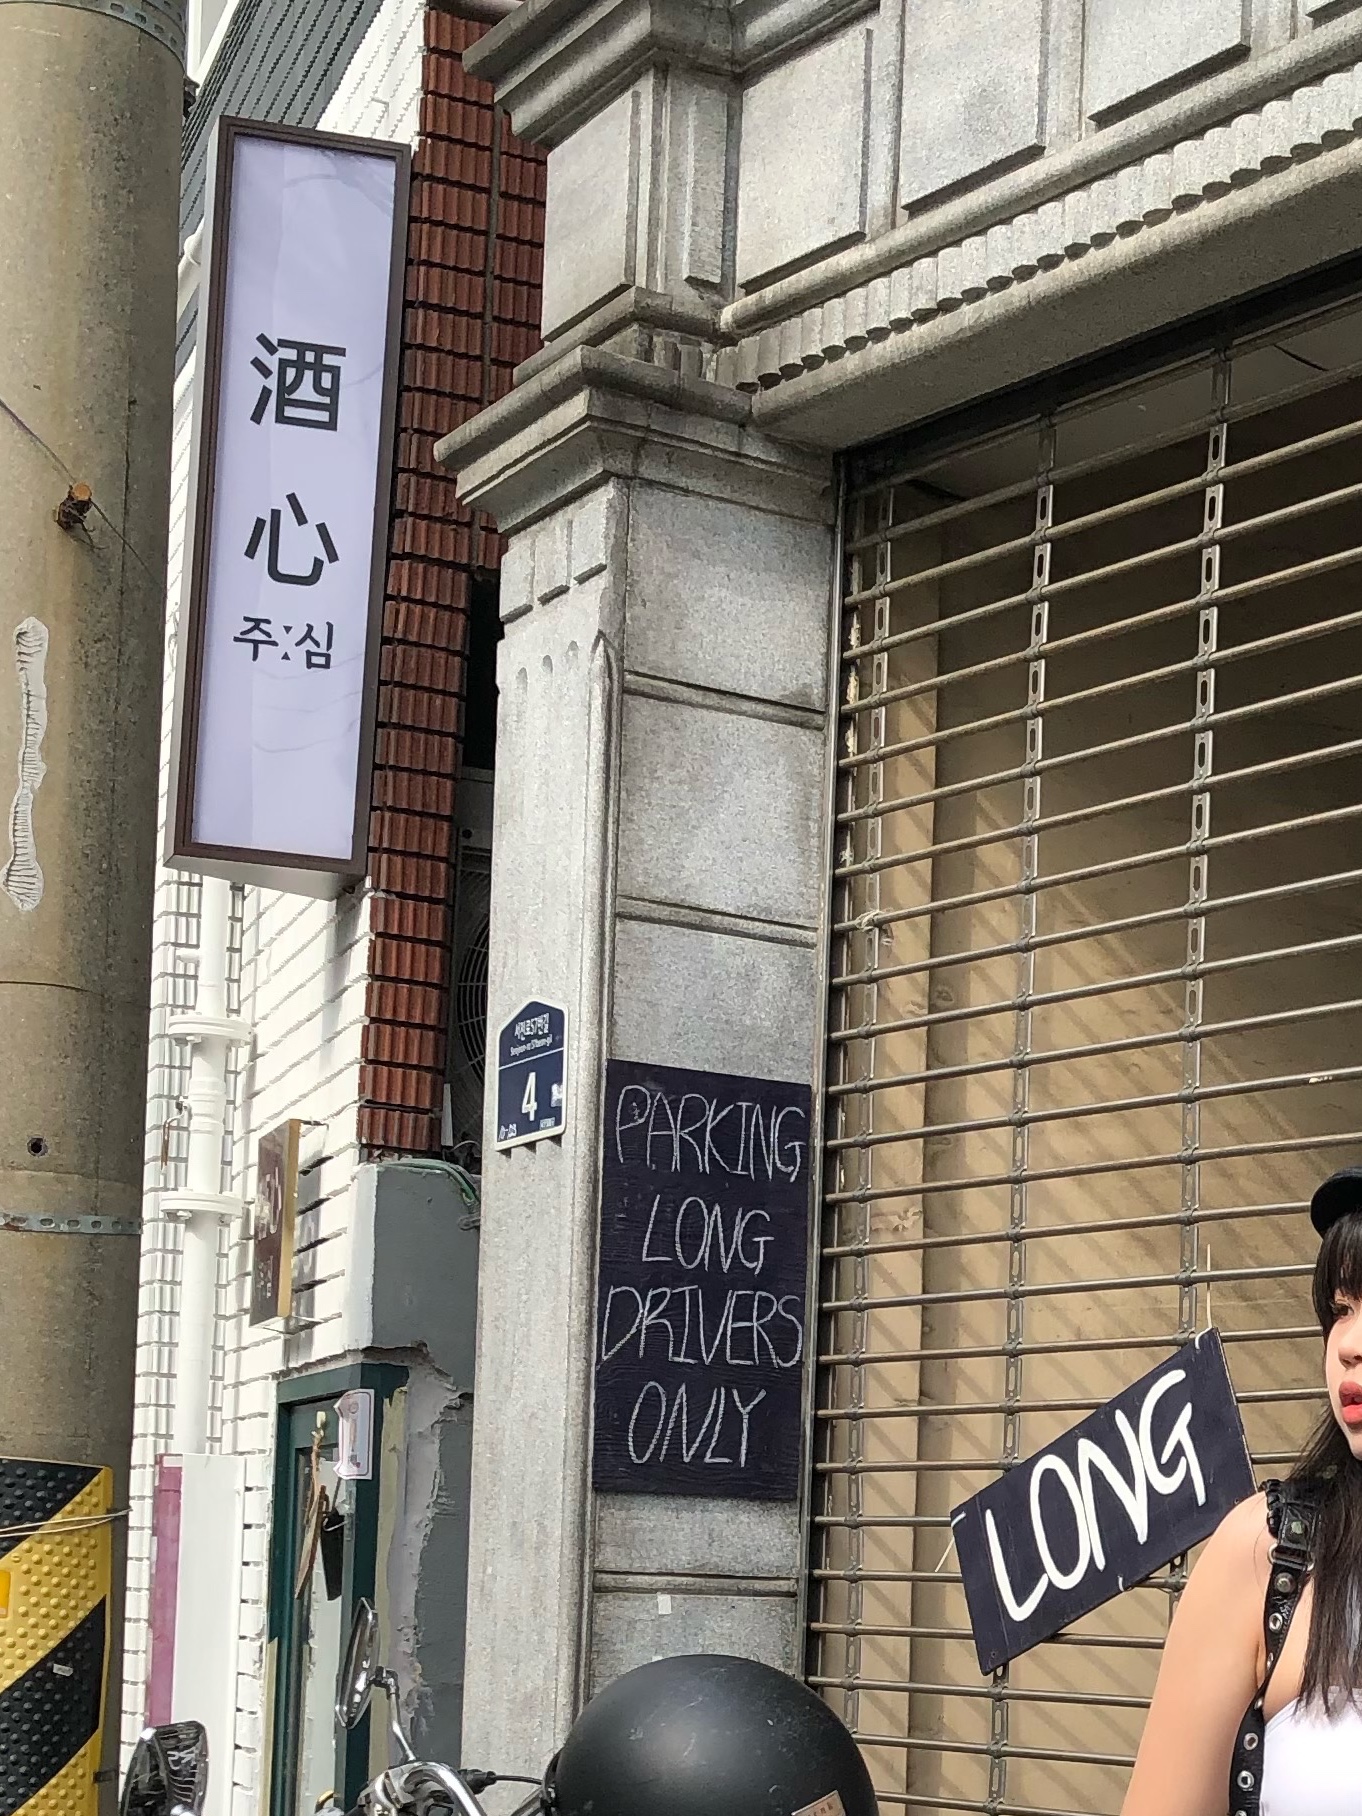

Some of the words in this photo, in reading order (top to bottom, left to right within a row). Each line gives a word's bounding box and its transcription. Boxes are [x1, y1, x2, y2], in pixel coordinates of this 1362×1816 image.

[521, 1071, 538, 1122] 4
[615, 1084, 806, 1183] PARKING
[642, 1194, 775, 1277] LONG
[597, 1285, 803, 1369] DRIVERS
[628, 1380, 767, 1468] ONLY
[985, 1369, 1206, 1622] LONG
